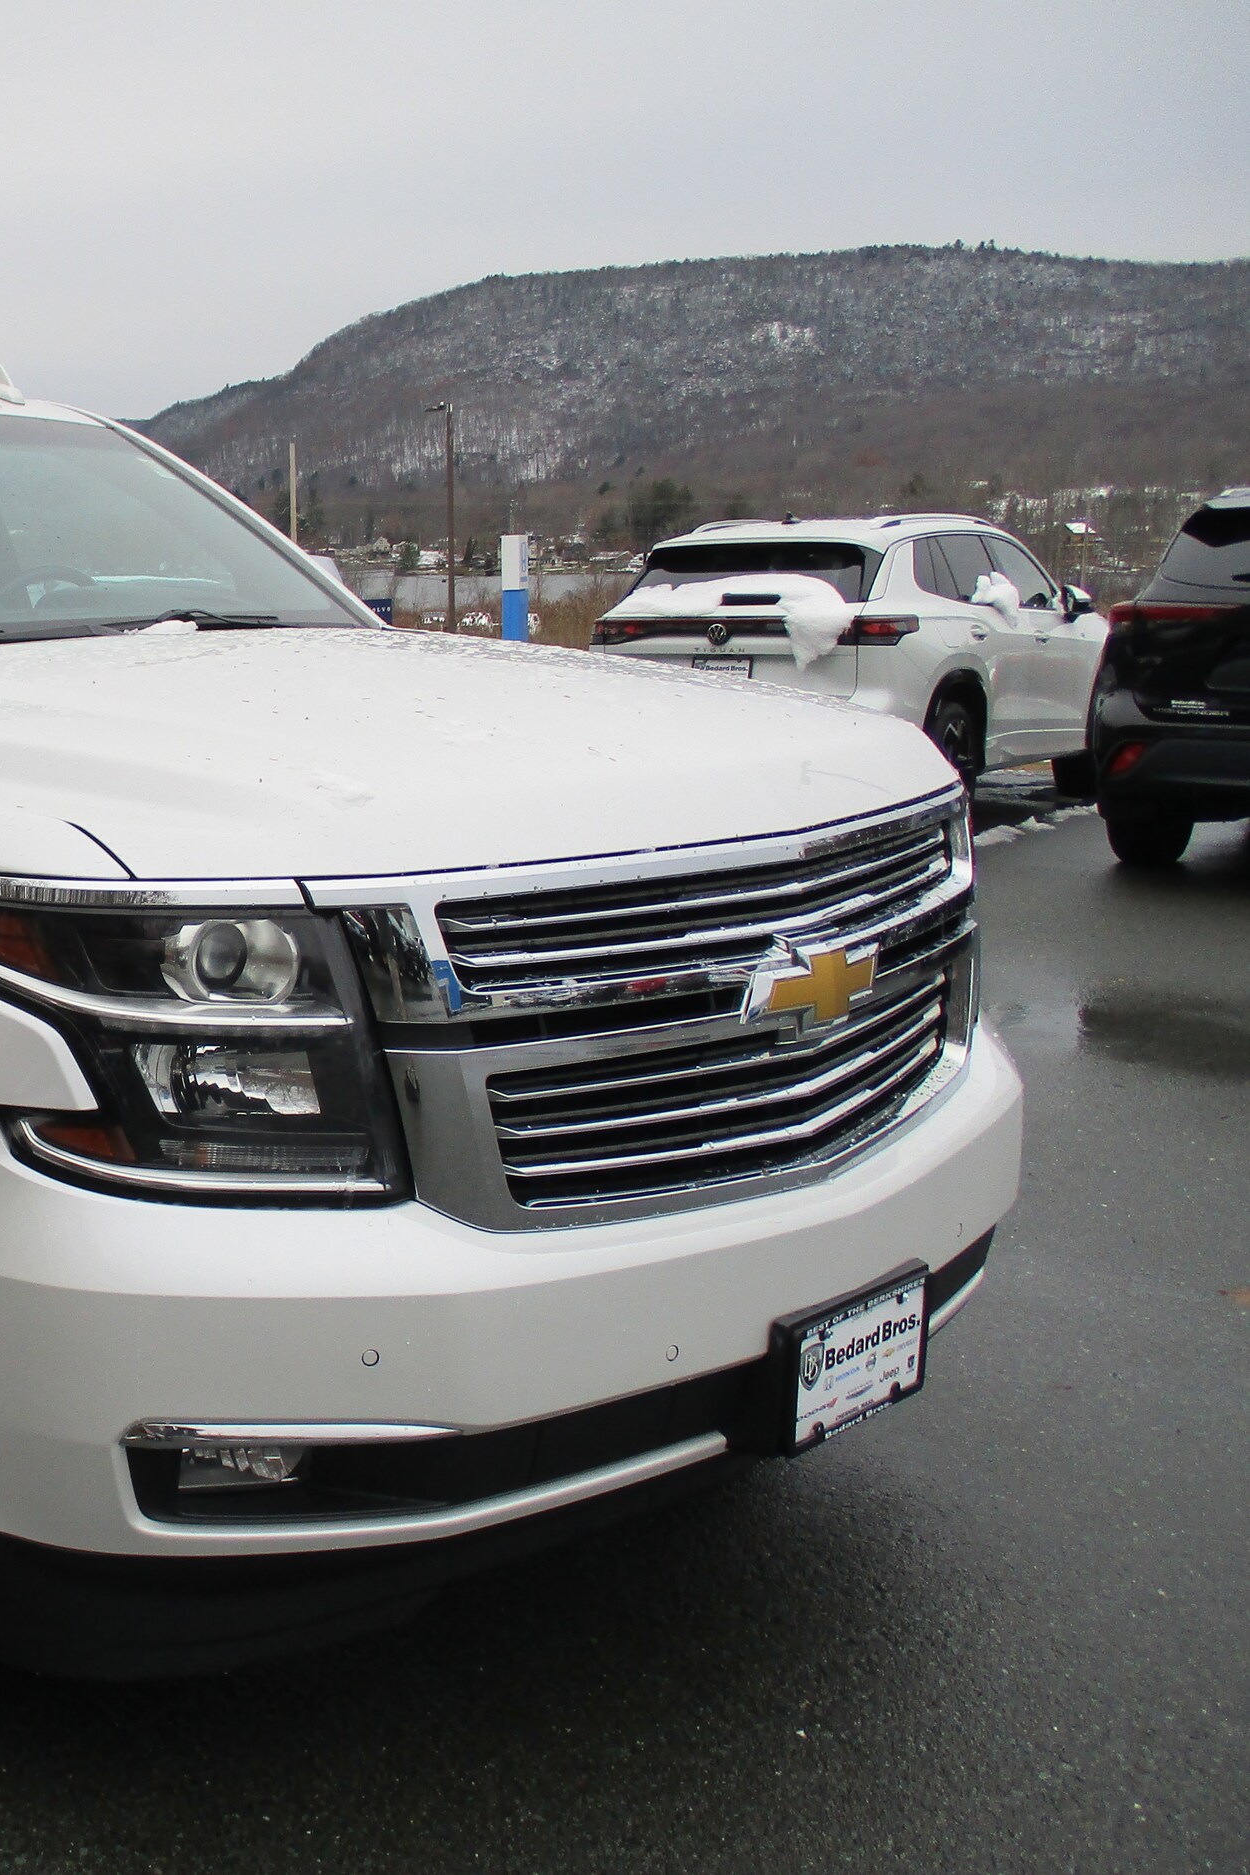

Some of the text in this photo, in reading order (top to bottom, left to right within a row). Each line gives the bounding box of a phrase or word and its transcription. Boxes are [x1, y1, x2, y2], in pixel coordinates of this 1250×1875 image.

[806, 1320, 831, 1337] BEST
[832, 1313, 846, 1325] OF
[847, 1303, 866, 1317] THE
[824, 1313, 921, 1370] Bedard Bros.
[879, 1366, 900, 1383] Jeep
[825, 1401, 893, 1440] Bedard Bros.
